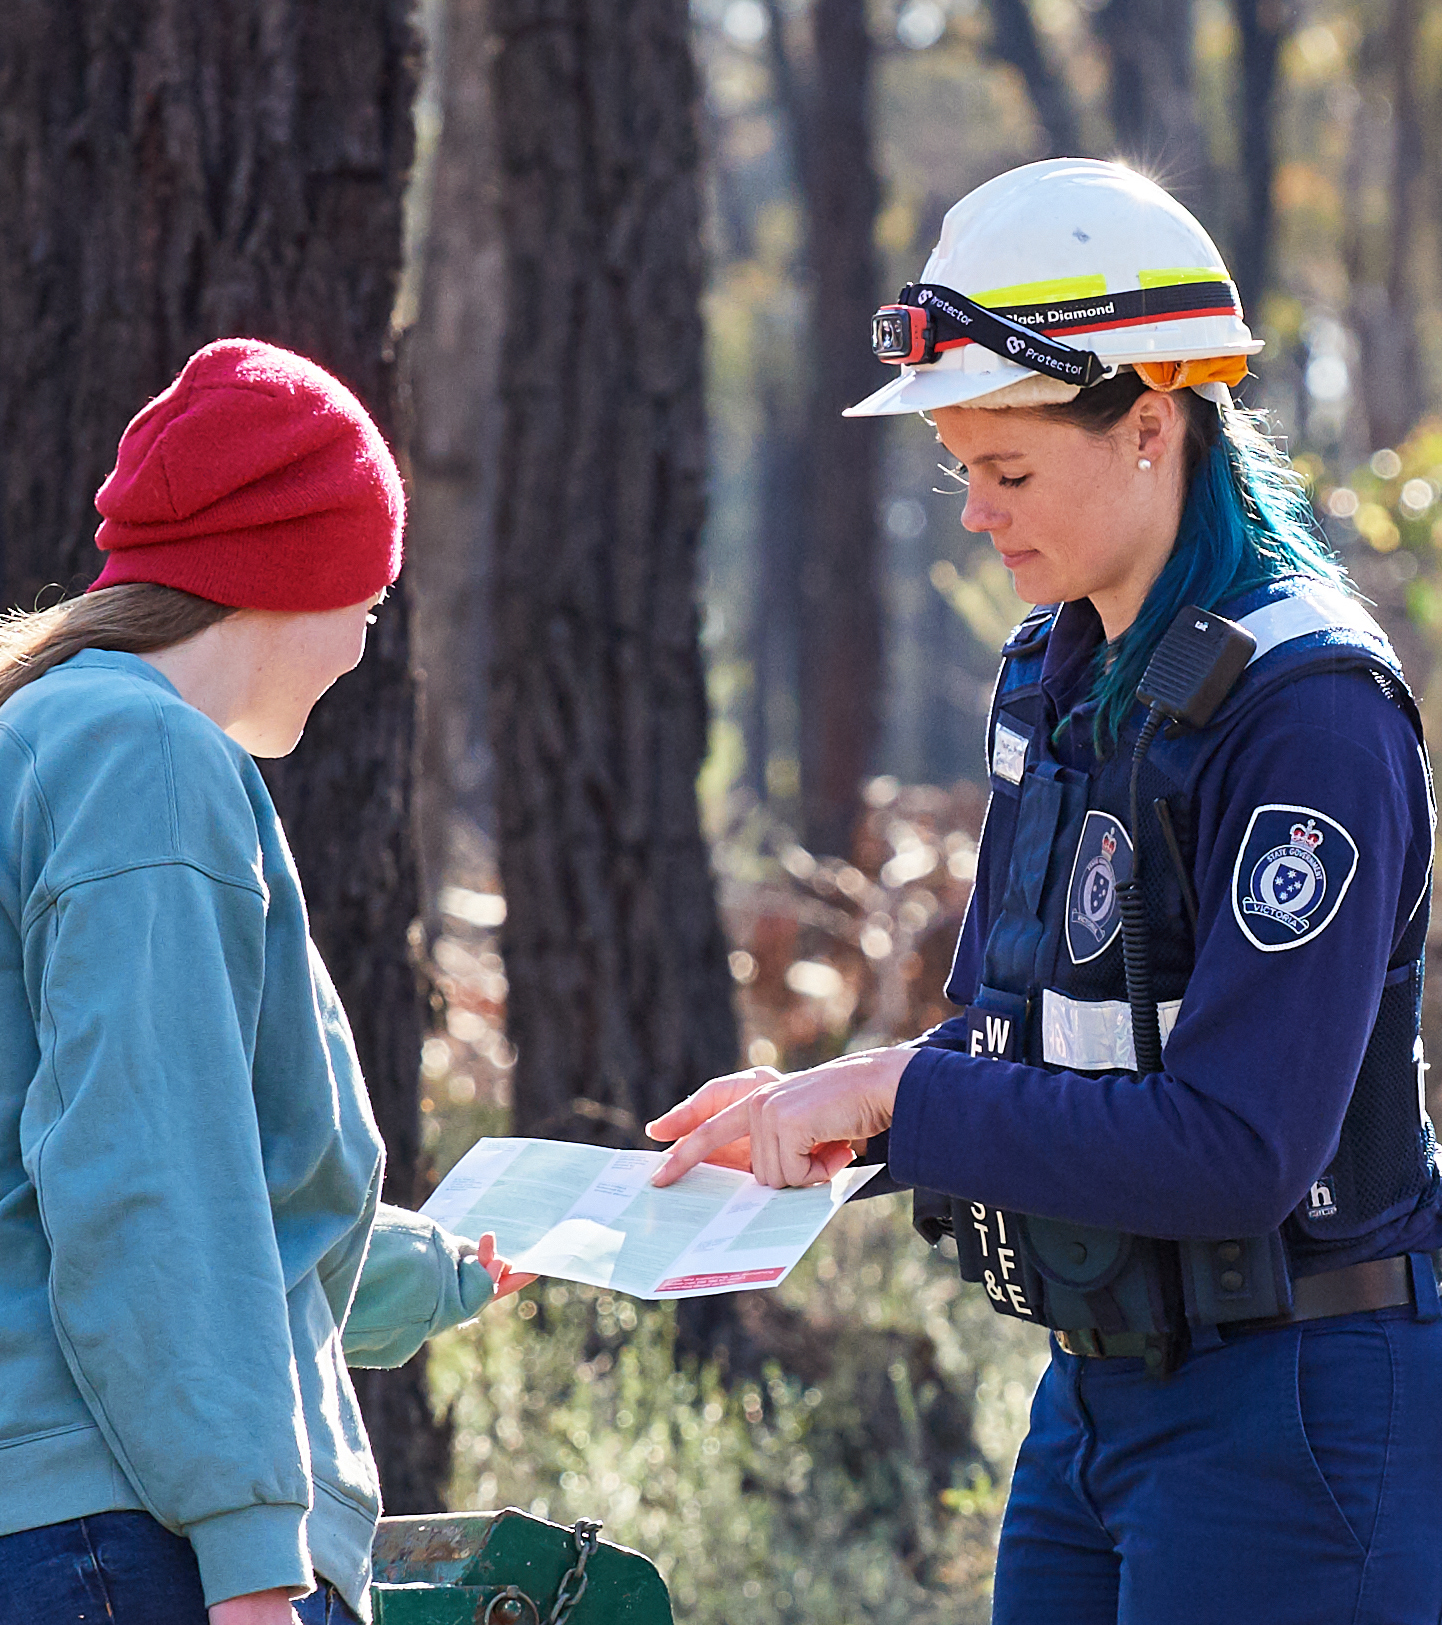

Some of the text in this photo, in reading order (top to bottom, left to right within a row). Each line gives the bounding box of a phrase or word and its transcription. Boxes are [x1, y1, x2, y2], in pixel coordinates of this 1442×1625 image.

[1006, 301, 1115, 325] lack Diamond
[1025, 348, 1083, 376] Protector
[1253, 903, 1297, 927] VICTORIA
[984, 1269, 1008, 1302] &
